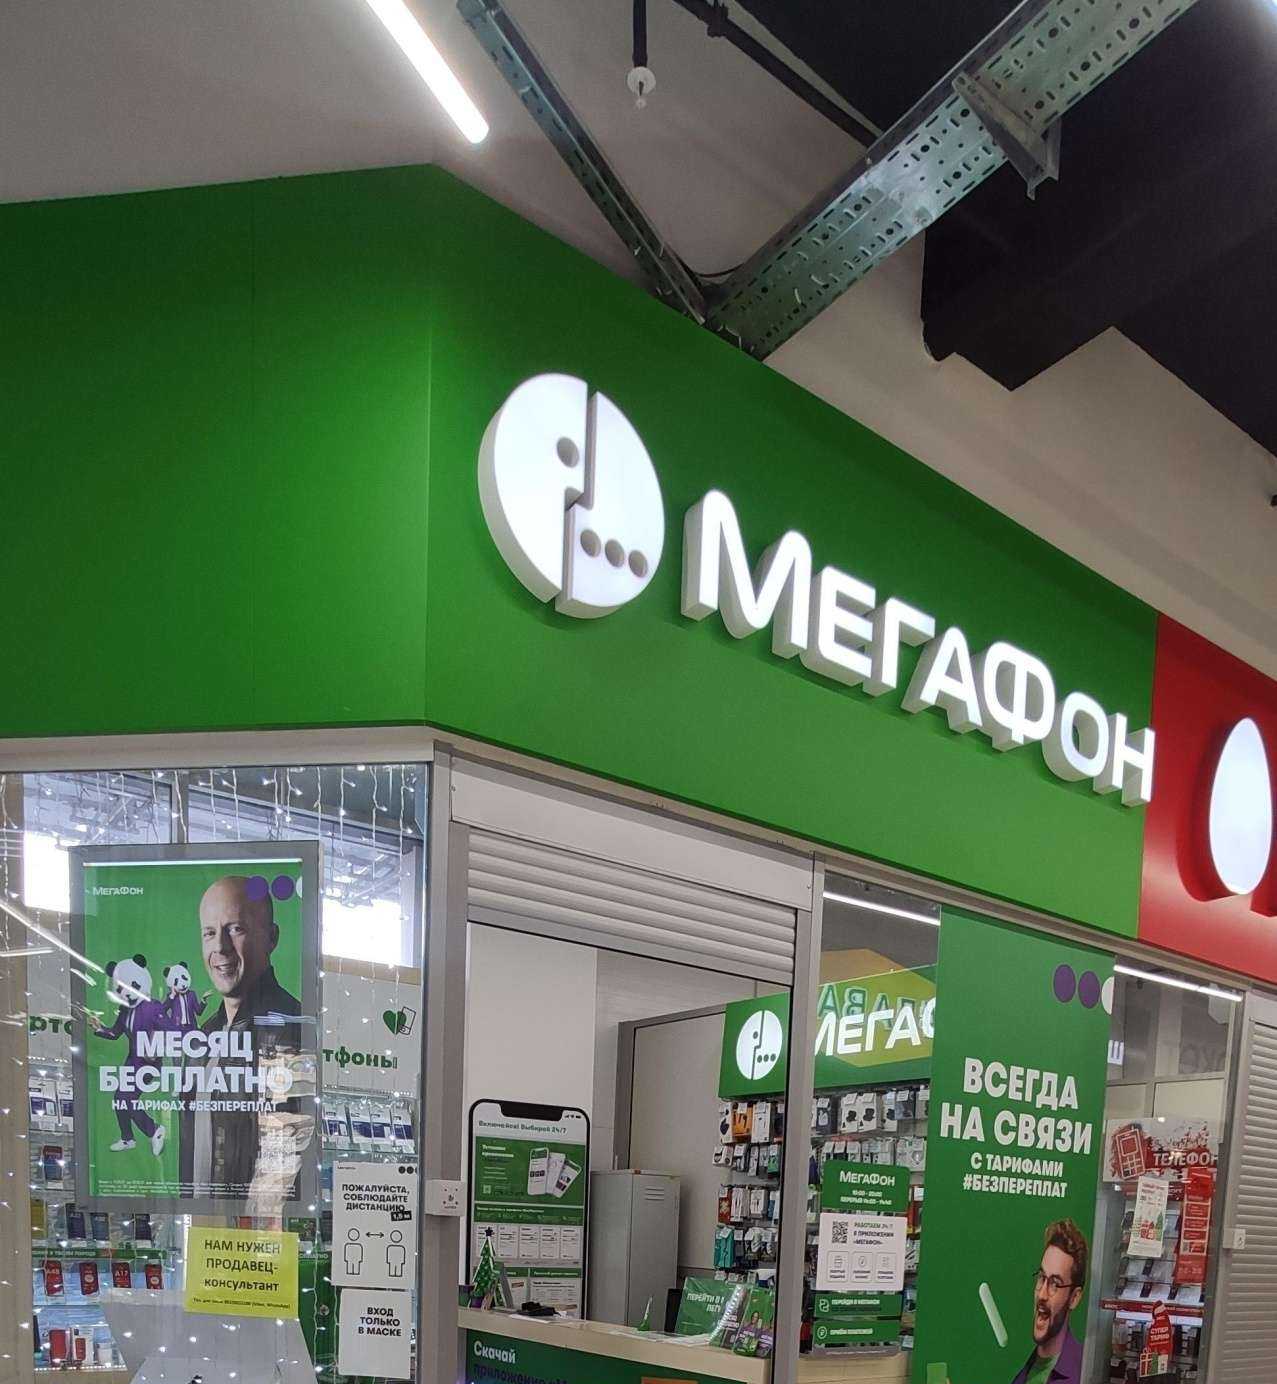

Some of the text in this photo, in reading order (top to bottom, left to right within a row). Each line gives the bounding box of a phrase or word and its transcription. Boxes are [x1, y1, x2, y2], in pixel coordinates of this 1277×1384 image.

[815, 997, 936, 1056] ЕГА
[136, 1030, 253, 1061] МЕСЯЦ
[100, 1066, 293, 1093] БЕСПЛАТНО
[963, 1057, 1078, 1110] ВСЕГДА
[112, 1100, 277, 1112] НА ТАРИФАХ #БЕЗПЕРЕПЛАТ
[940, 1102, 1092, 1154] НА СВЯЗИ
[970, 1152, 1063, 1177] С ТАРИФАМИ
[342, 1184, 409, 1194] ПОЖАЛУЙСТА,
[963, 1174, 1067, 1197] #БЕЗПЕРЕПЛАТ
[344, 1193, 408, 1202] СОБЛЮДАЙТЕ
[346, 1203, 405, 1211] ДИСТАНЦИЮ
[205, 1240, 280, 1254] НАМ НУЖЕН
[206, 1258, 278, 1274] ПРОДАВЕЦ-
[205, 1279, 279, 1291] консультант
[367, 1307, 393, 1316] ВХОД
[360, 1317, 400, 1326] ТОЛЬКО
[358, 1326, 401, 1337] В МАСКЕ
[474, 1341, 516, 1364] Скачай
